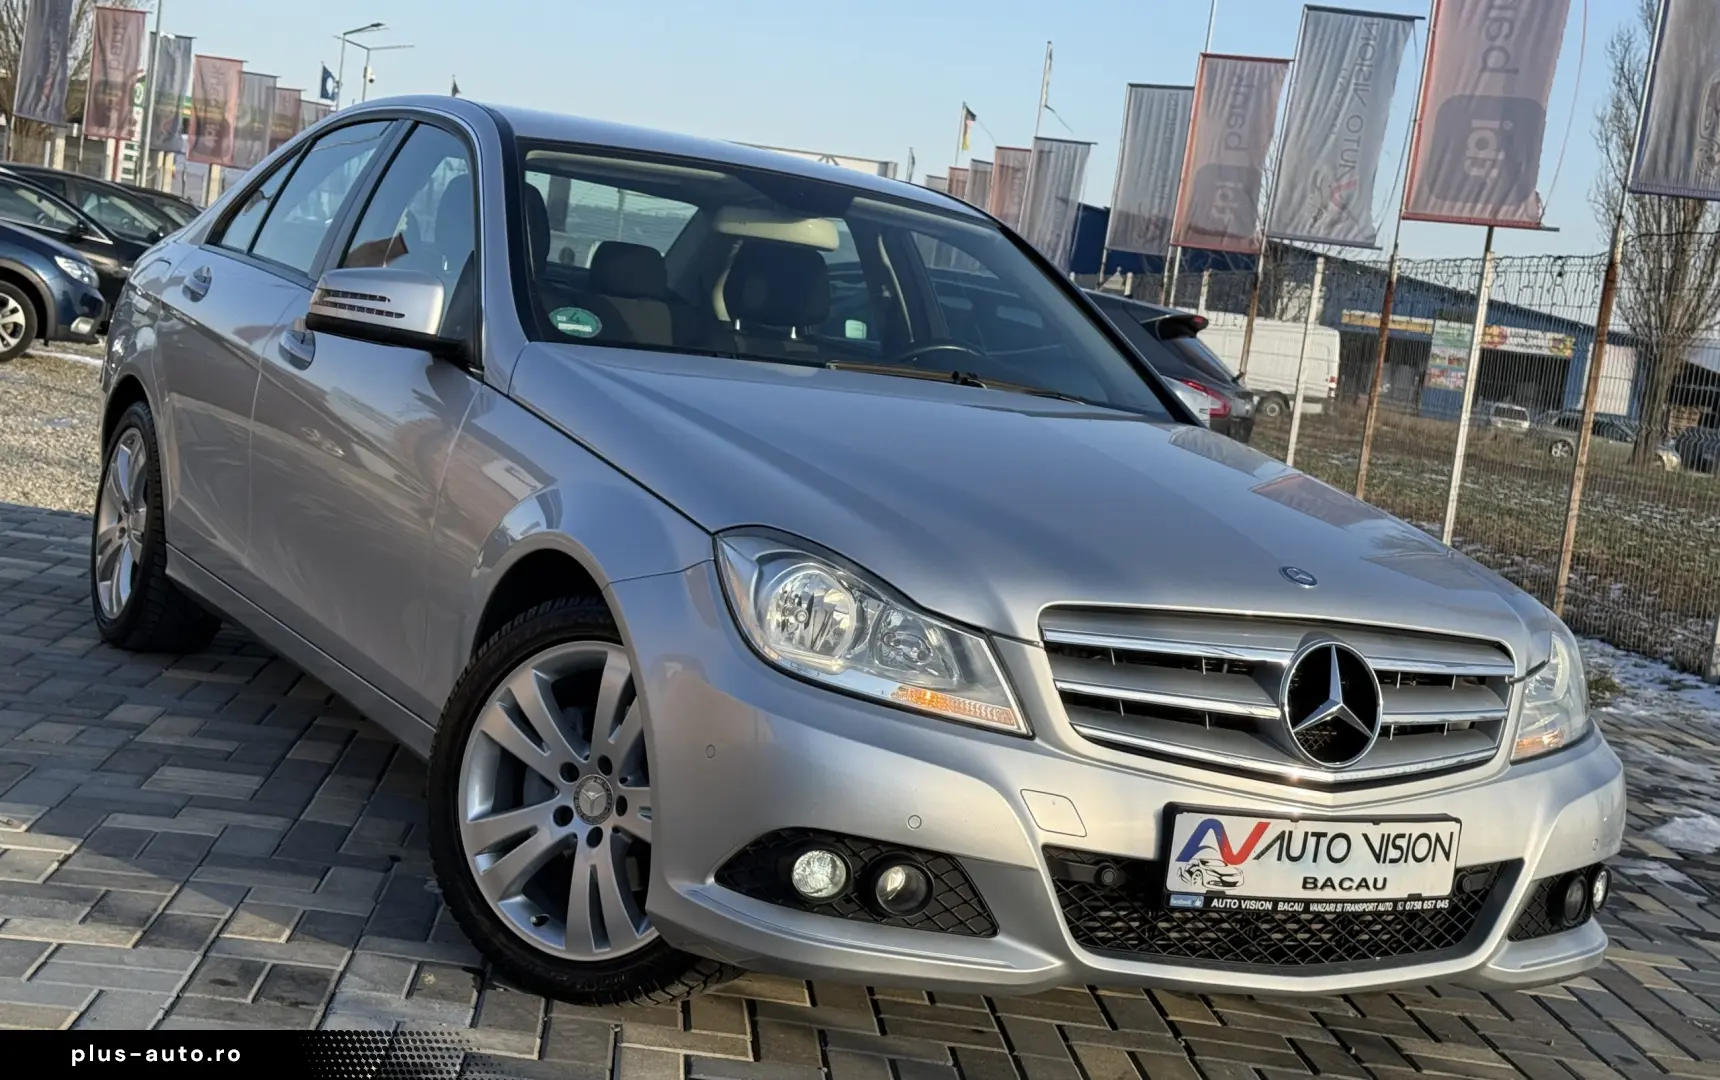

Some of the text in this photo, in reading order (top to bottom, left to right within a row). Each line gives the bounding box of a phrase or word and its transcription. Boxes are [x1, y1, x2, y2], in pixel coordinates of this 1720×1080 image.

[1253, 830, 1352, 863] AUTO
[1361, 831, 1454, 864] VISION
[1301, 876, 1388, 892] BACAU
[1210, 898, 1239, 909] AUTO
[1241, 900, 1273, 911] VISION
[1277, 901, 1305, 912] BACAU
[1309, 902, 1336, 912] VANZARI
[1343, 902, 1378, 912] TRANSPORT
